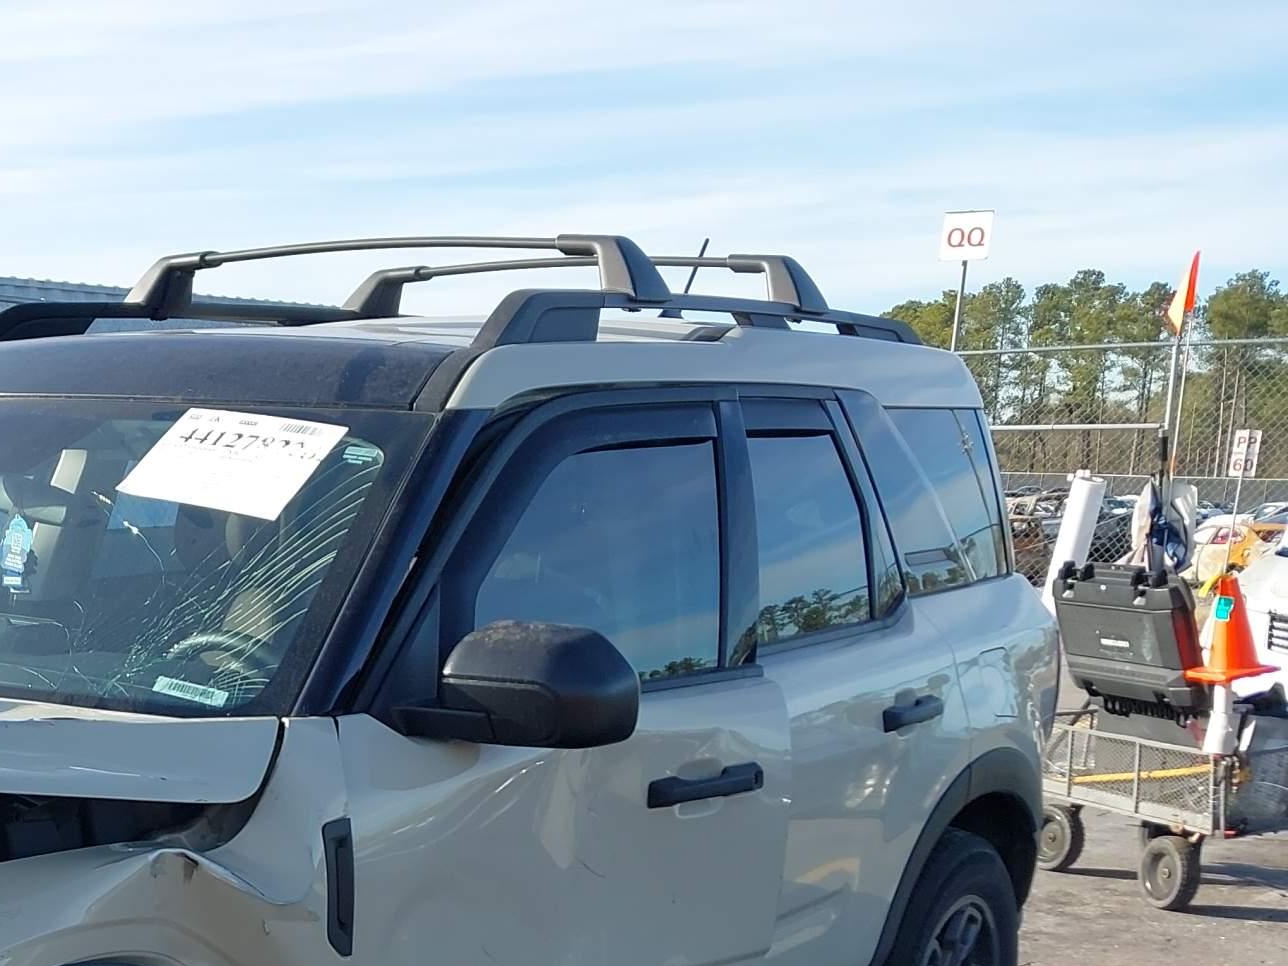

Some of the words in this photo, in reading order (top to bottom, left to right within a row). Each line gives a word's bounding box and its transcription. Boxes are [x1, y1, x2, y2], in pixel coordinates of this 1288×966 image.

[946, 227, 985, 248] QQ
[1237, 436, 1258, 449] PP
[1232, 458, 1254, 472] 60
